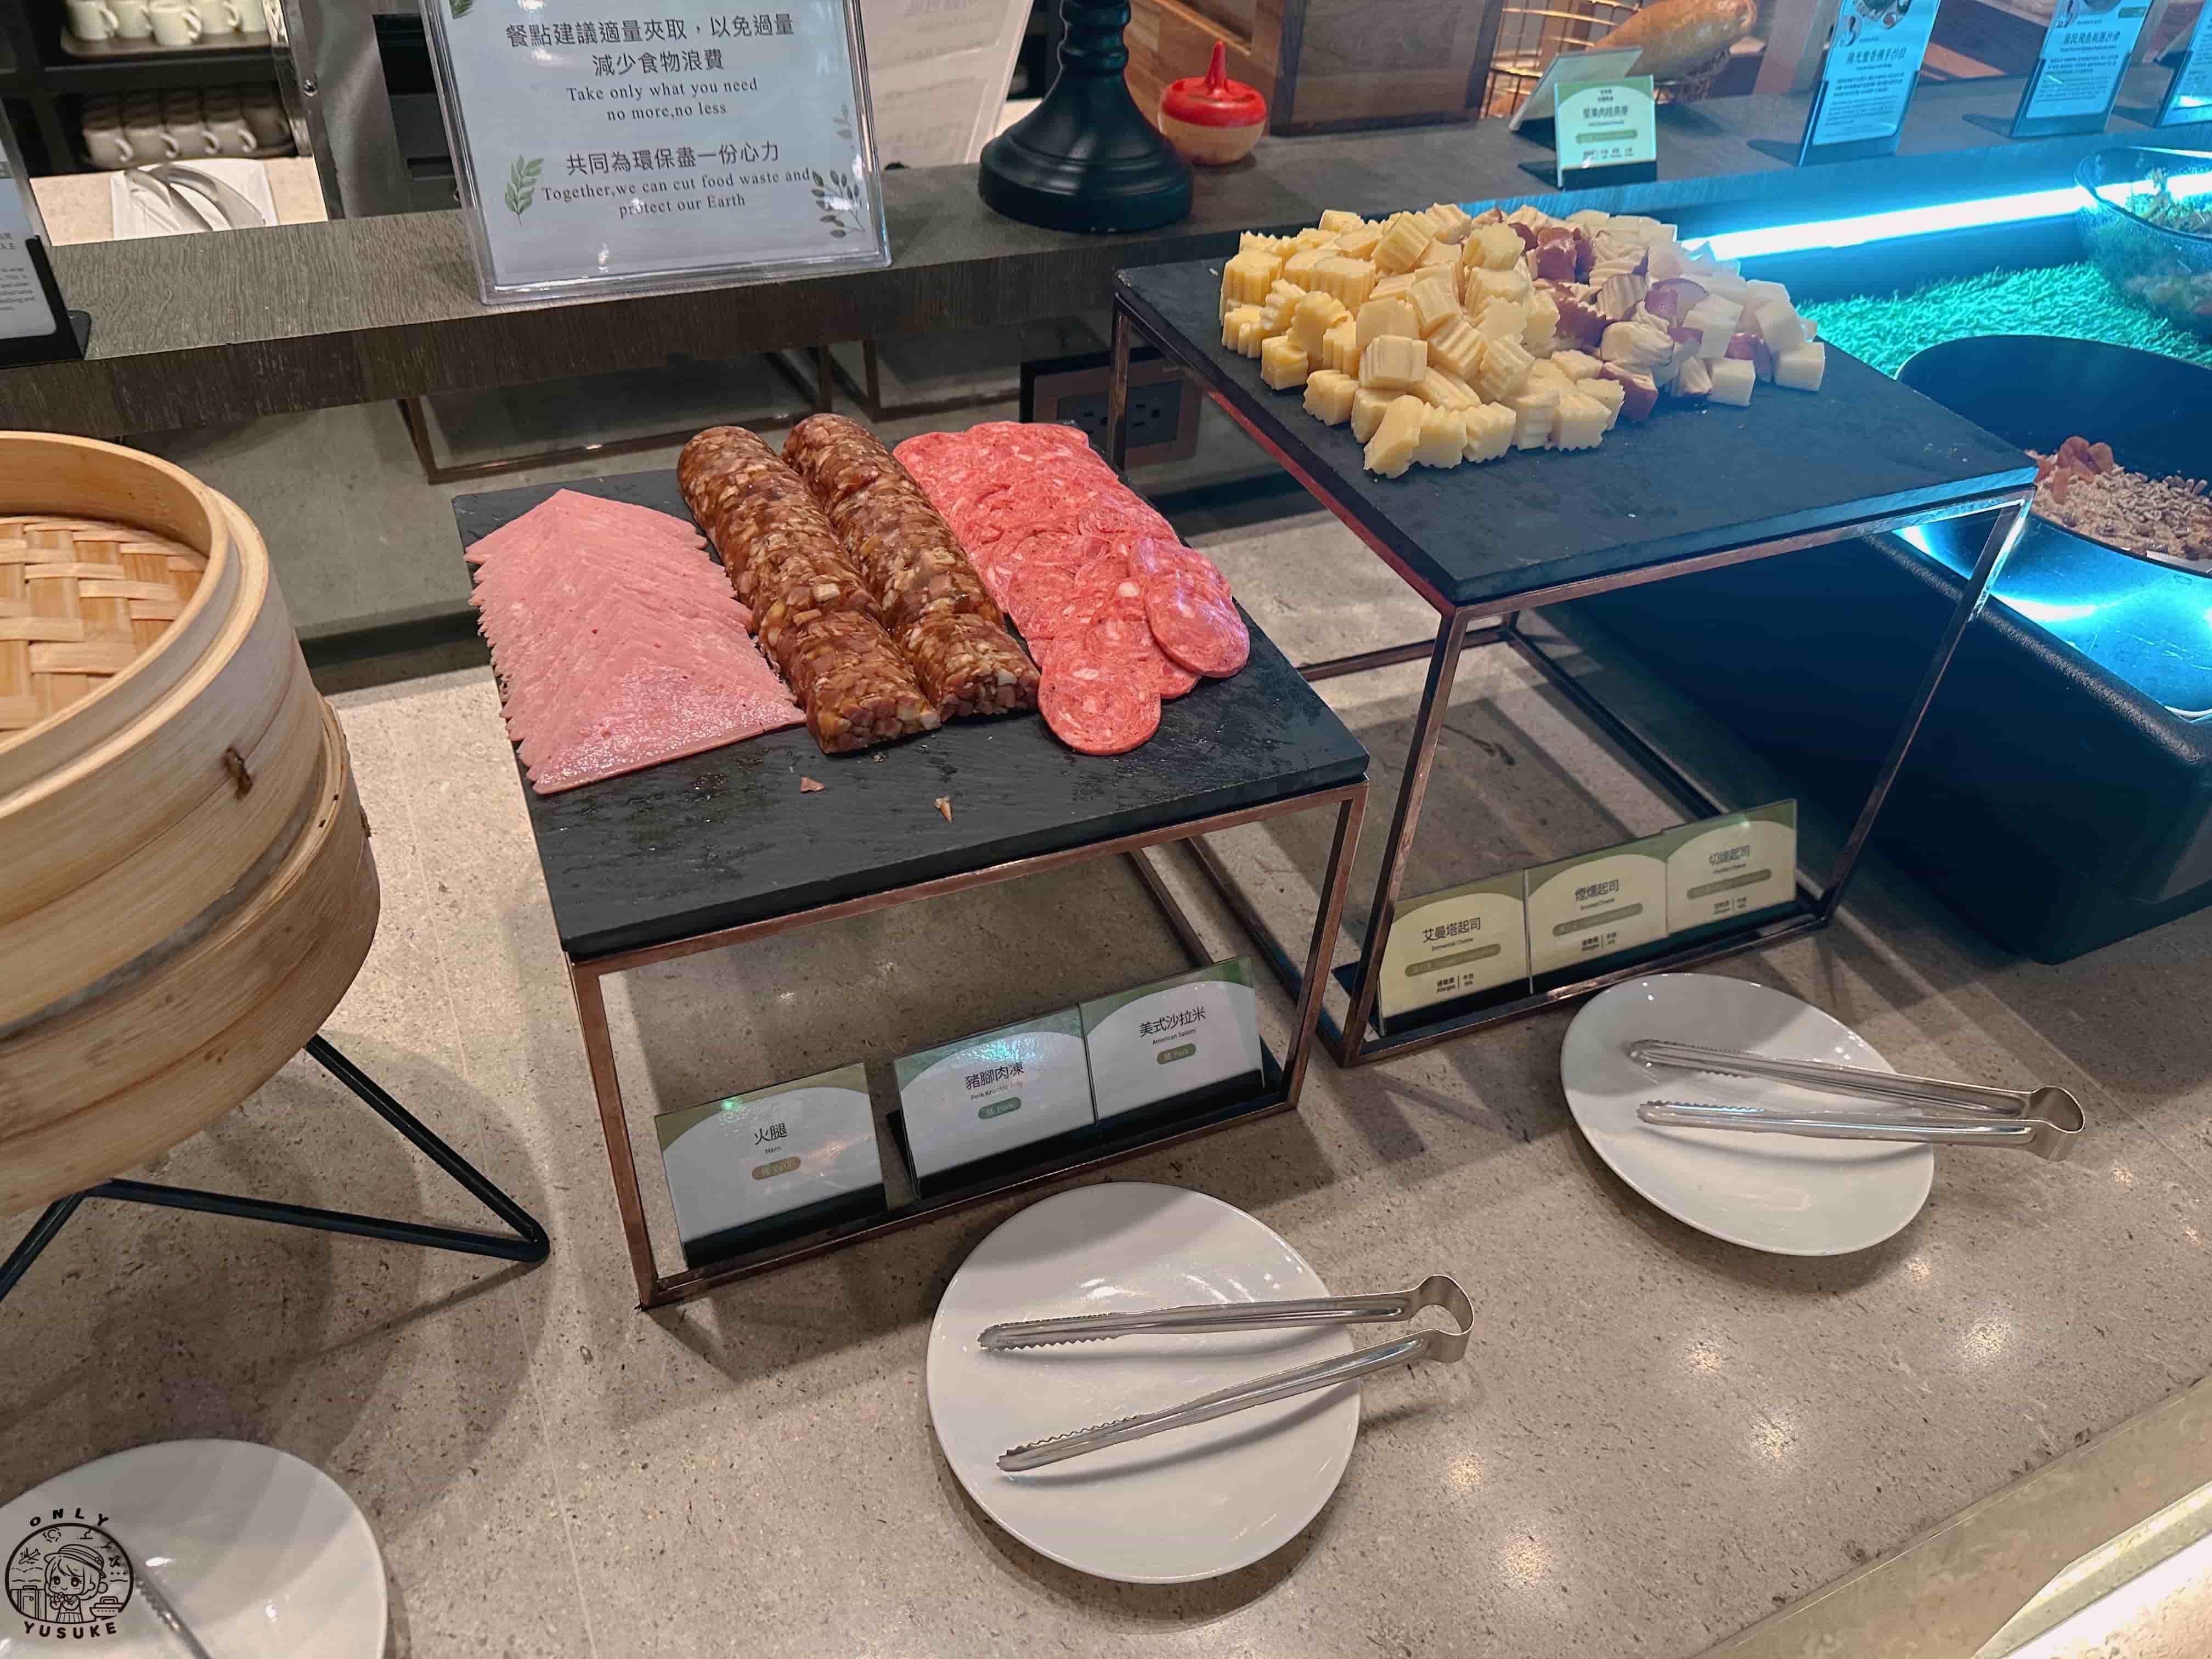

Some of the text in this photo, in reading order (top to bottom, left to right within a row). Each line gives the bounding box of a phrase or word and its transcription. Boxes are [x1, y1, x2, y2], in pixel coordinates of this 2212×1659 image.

[506, 13, 794, 48] 餐點建議適量夾取，以免過量
[592, 48, 724, 76] 減少食物浪費
[566, 76, 758, 101] Take only what you need
[607, 109, 625, 121] no
[698, 101, 727, 115] less
[566, 140, 778, 176] 共同為環保盡一份心力
[541, 167, 810, 202] Together,we can cut food waste and
[619, 193, 747, 219] protect our Earth
[1422, 917, 1481, 943] 艾曼塔起司
[1139, 1006, 1206, 1037] 美式沙拉米
[754, 1123, 788, 1145] 火腿
